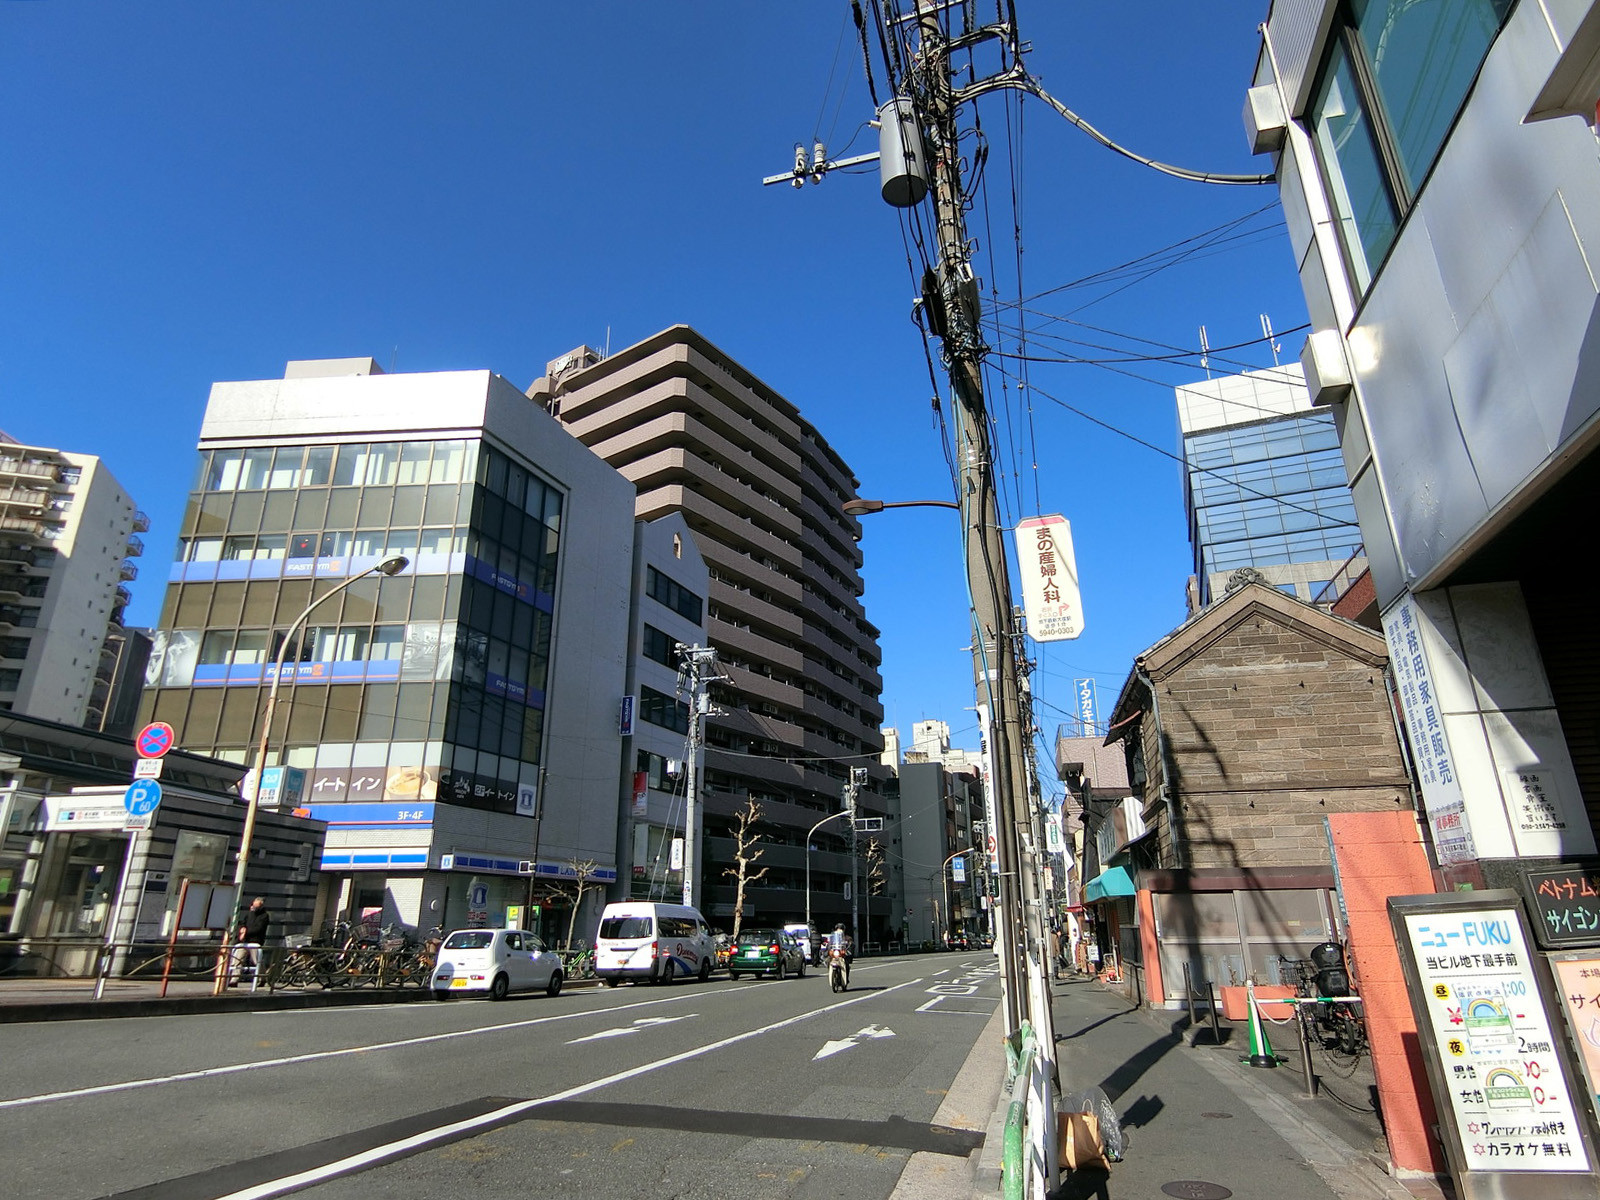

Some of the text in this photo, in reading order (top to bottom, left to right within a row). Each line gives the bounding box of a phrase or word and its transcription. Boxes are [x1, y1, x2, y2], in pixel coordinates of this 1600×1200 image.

[1036, 527, 1061, 604] まの産婦人科
[1039, 627, 1074, 637] 5940-0303
[130, 788, 151, 812] P 60
[1539, 877, 1597, 900] ベトナム
[1426, 952, 1518, 970] 当ビル地下最手前
[1448, 1040, 1463, 1054] 夜
[1518, 1036, 1551, 1054] 2時間
[1487, 1142, 1572, 1157] カラオケ無料
